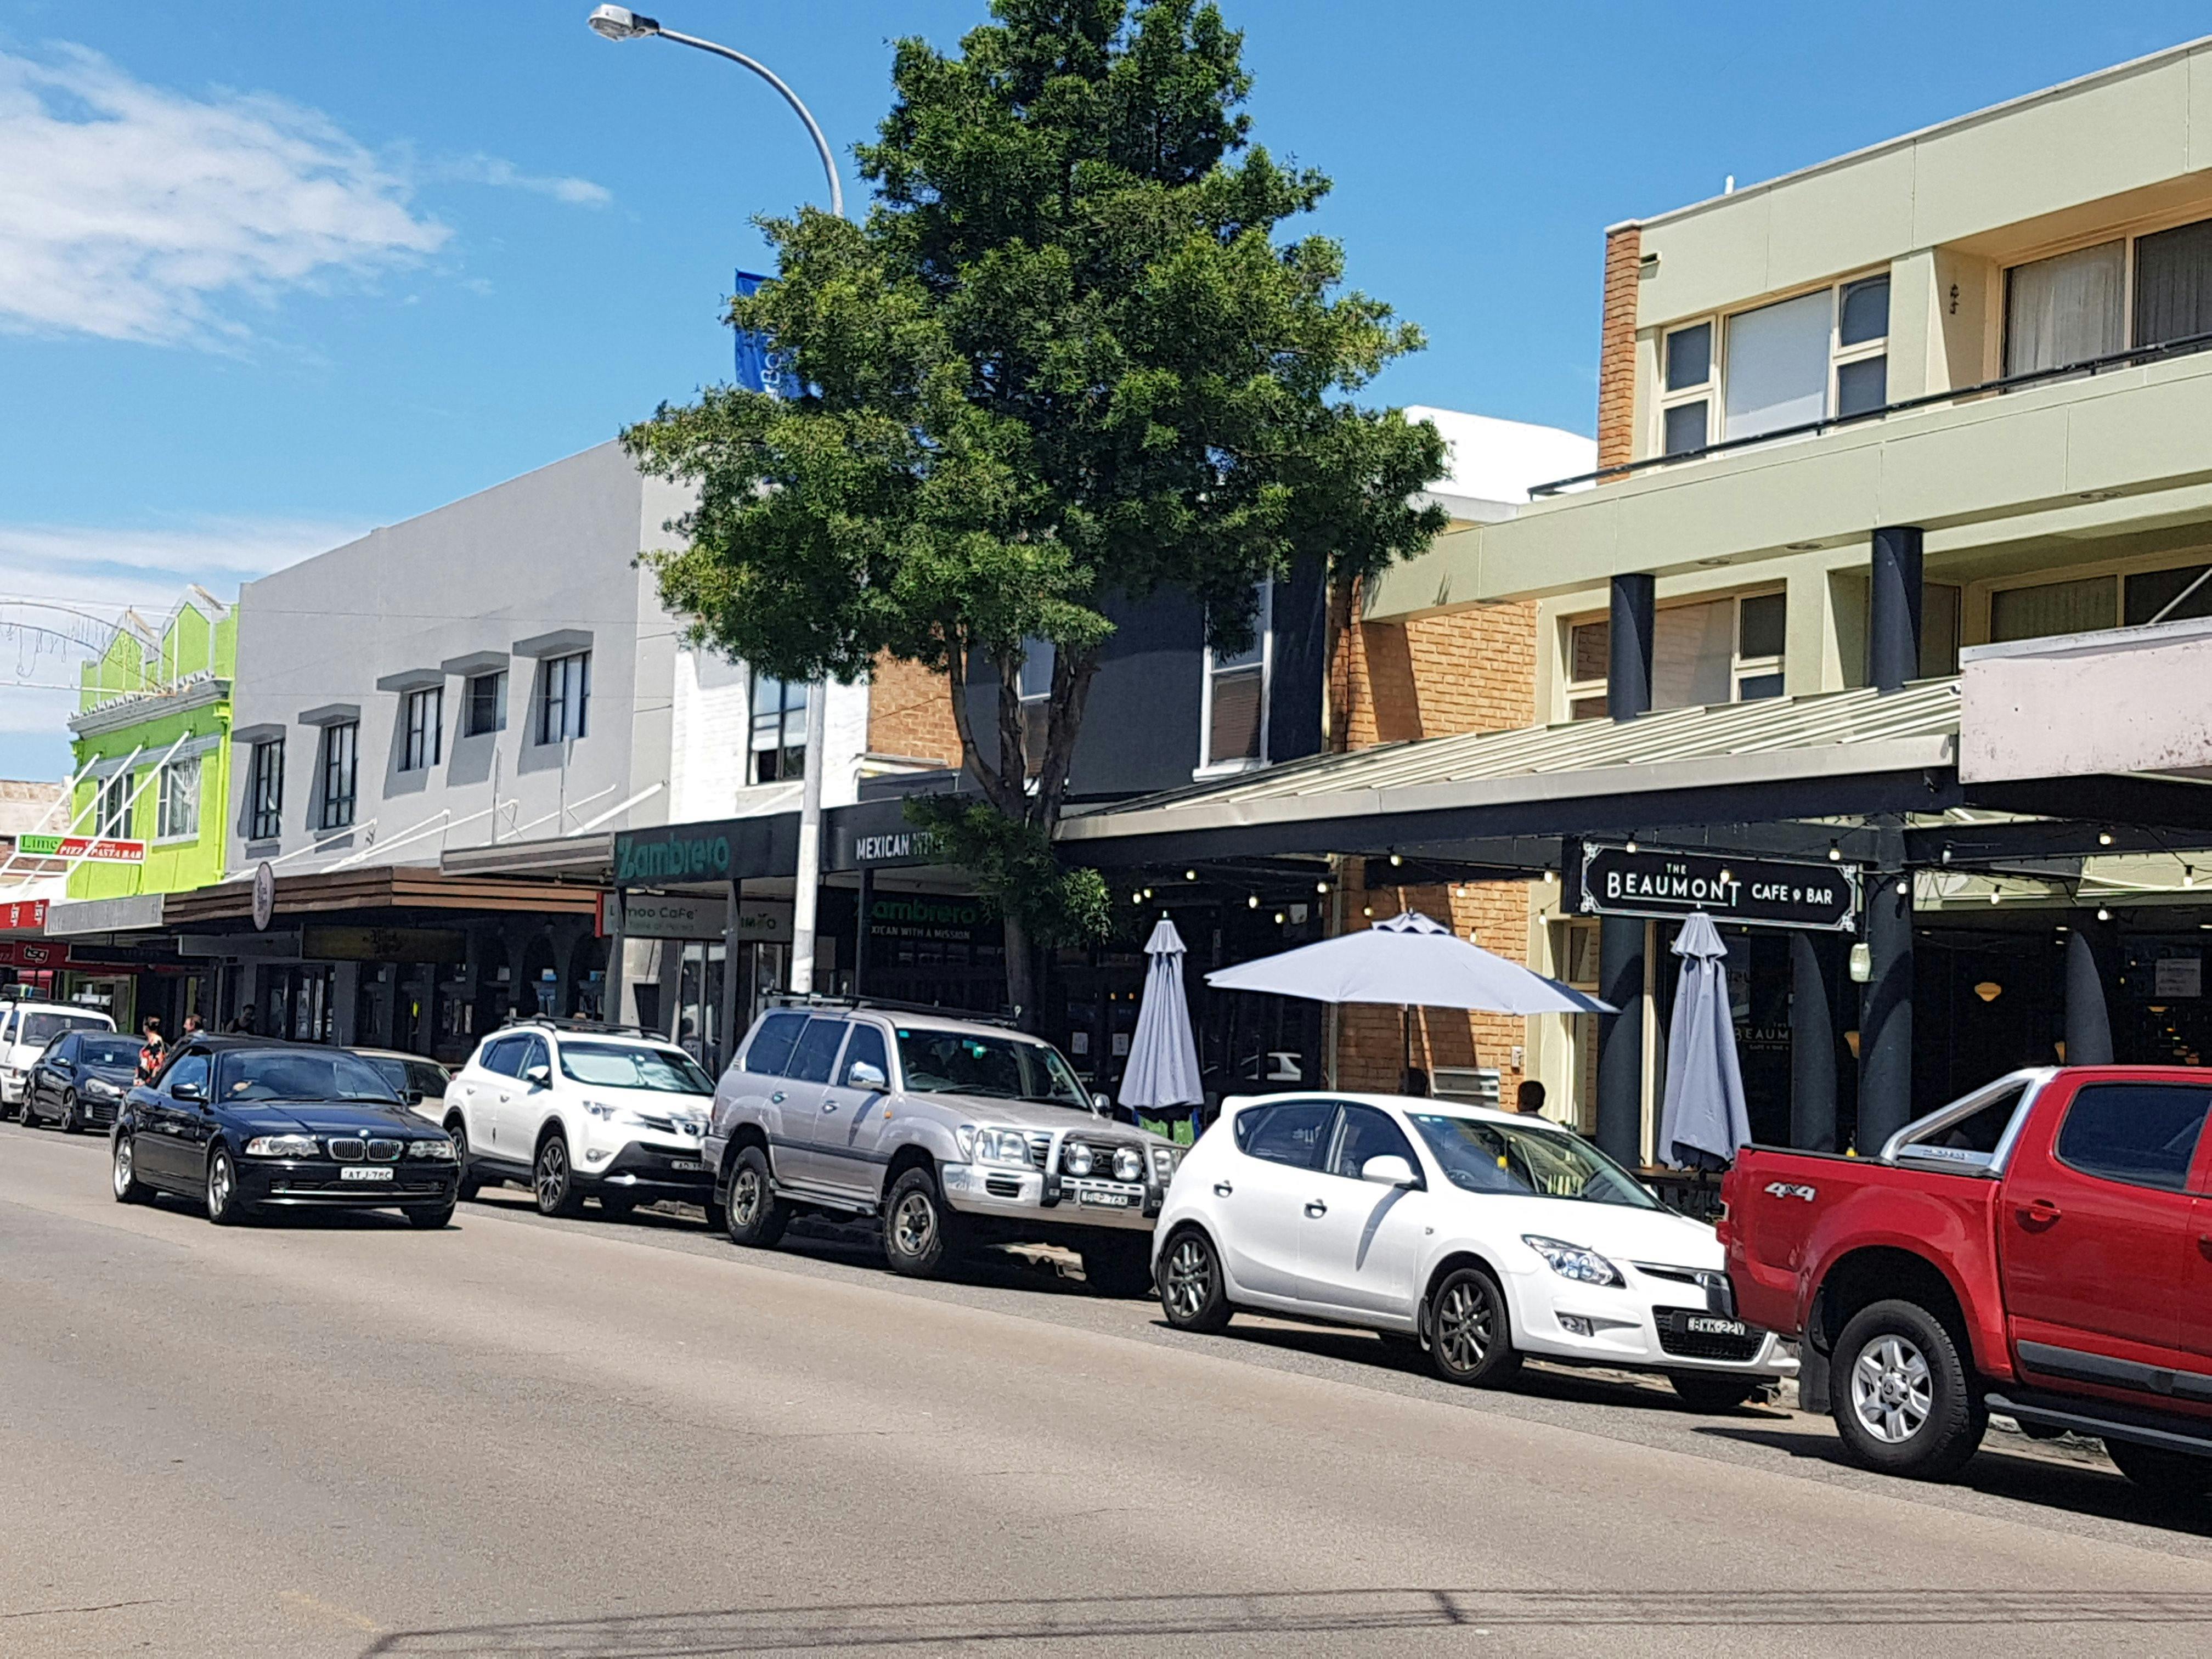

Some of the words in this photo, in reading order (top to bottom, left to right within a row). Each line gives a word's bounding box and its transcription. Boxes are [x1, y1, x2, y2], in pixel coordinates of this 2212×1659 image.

[22, 835, 58, 849] Lime
[856, 833, 910, 860] MEXICAN
[59, 845, 83, 855] PIZZ
[121, 850, 142, 859] BAR
[617, 832, 730, 879] Zambrero
[1666, 862, 1686, 874] THE
[1607, 871, 1741, 906] BEAUMONT
[1752, 883, 1788, 901] CAFE
[1806, 887, 1833, 904] BAR
[872, 899, 976, 924] ambrero
[933, 929, 970, 940] MISSION
[1735, 1027, 1789, 1041] BEAUM
